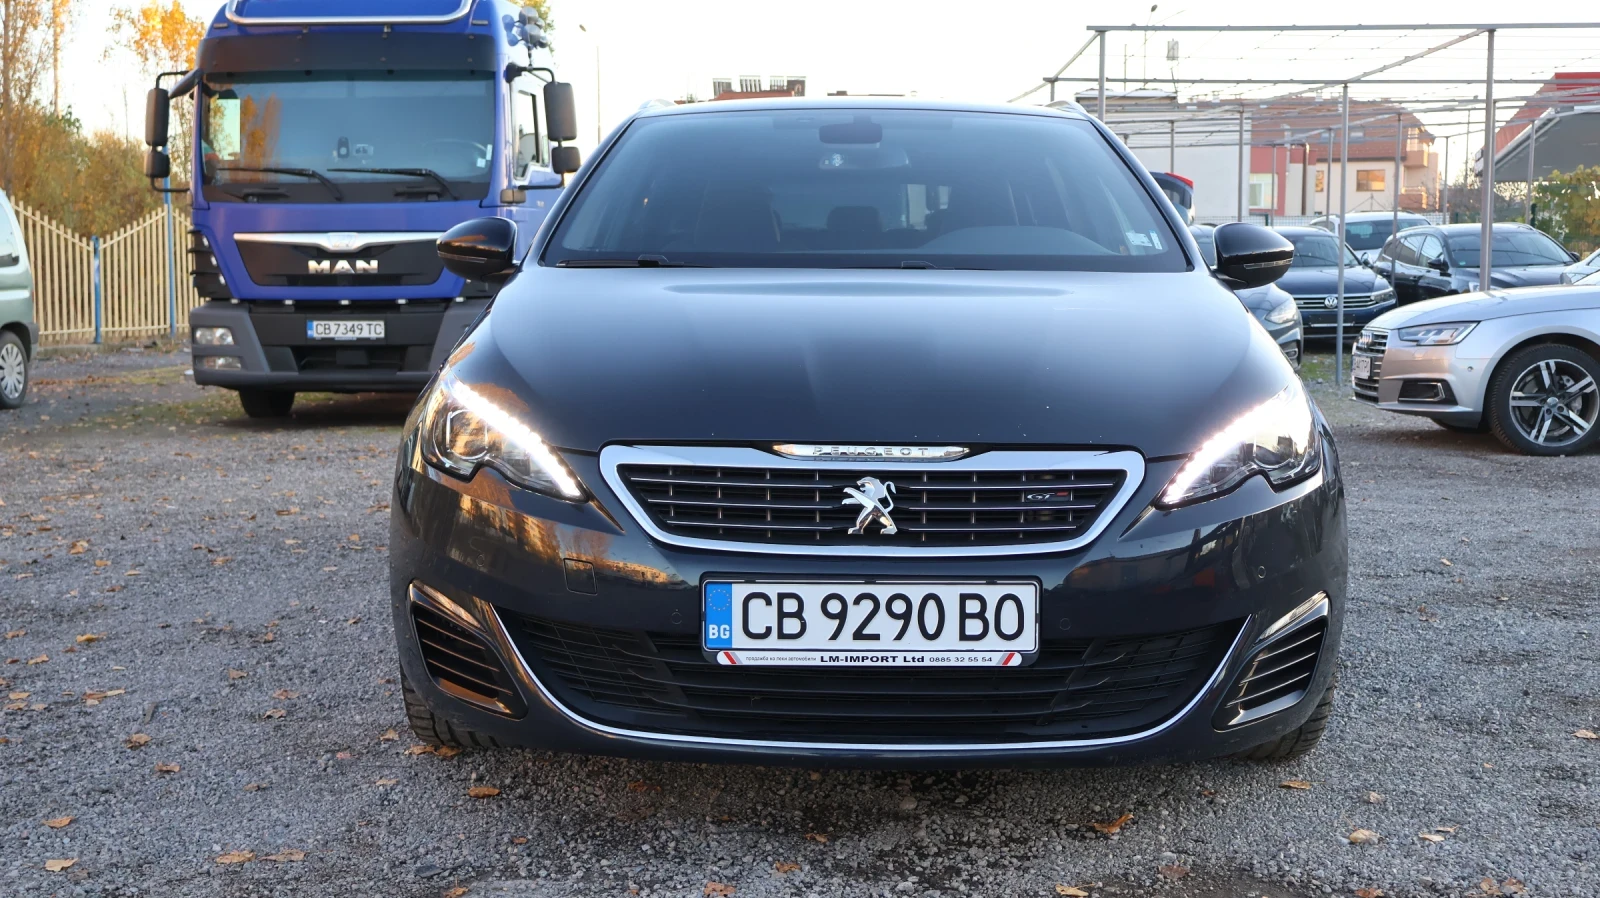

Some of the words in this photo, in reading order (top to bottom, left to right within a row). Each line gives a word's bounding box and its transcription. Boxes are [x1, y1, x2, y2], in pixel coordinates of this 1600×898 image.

[308, 260, 378, 274] MAN
[315, 323, 331, 335] CB
[334, 323, 363, 335] 7349
[366, 323, 382, 335] TC
[813, 446, 928, 456] PEUGEOT
[742, 591, 807, 640] CB
[820, 592, 946, 641] 9290
[958, 592, 1025, 641] BO
[708, 624, 730, 639] BG
[820, 655, 898, 663] LM-IMPORT
[903, 655, 925, 663] Ltd
